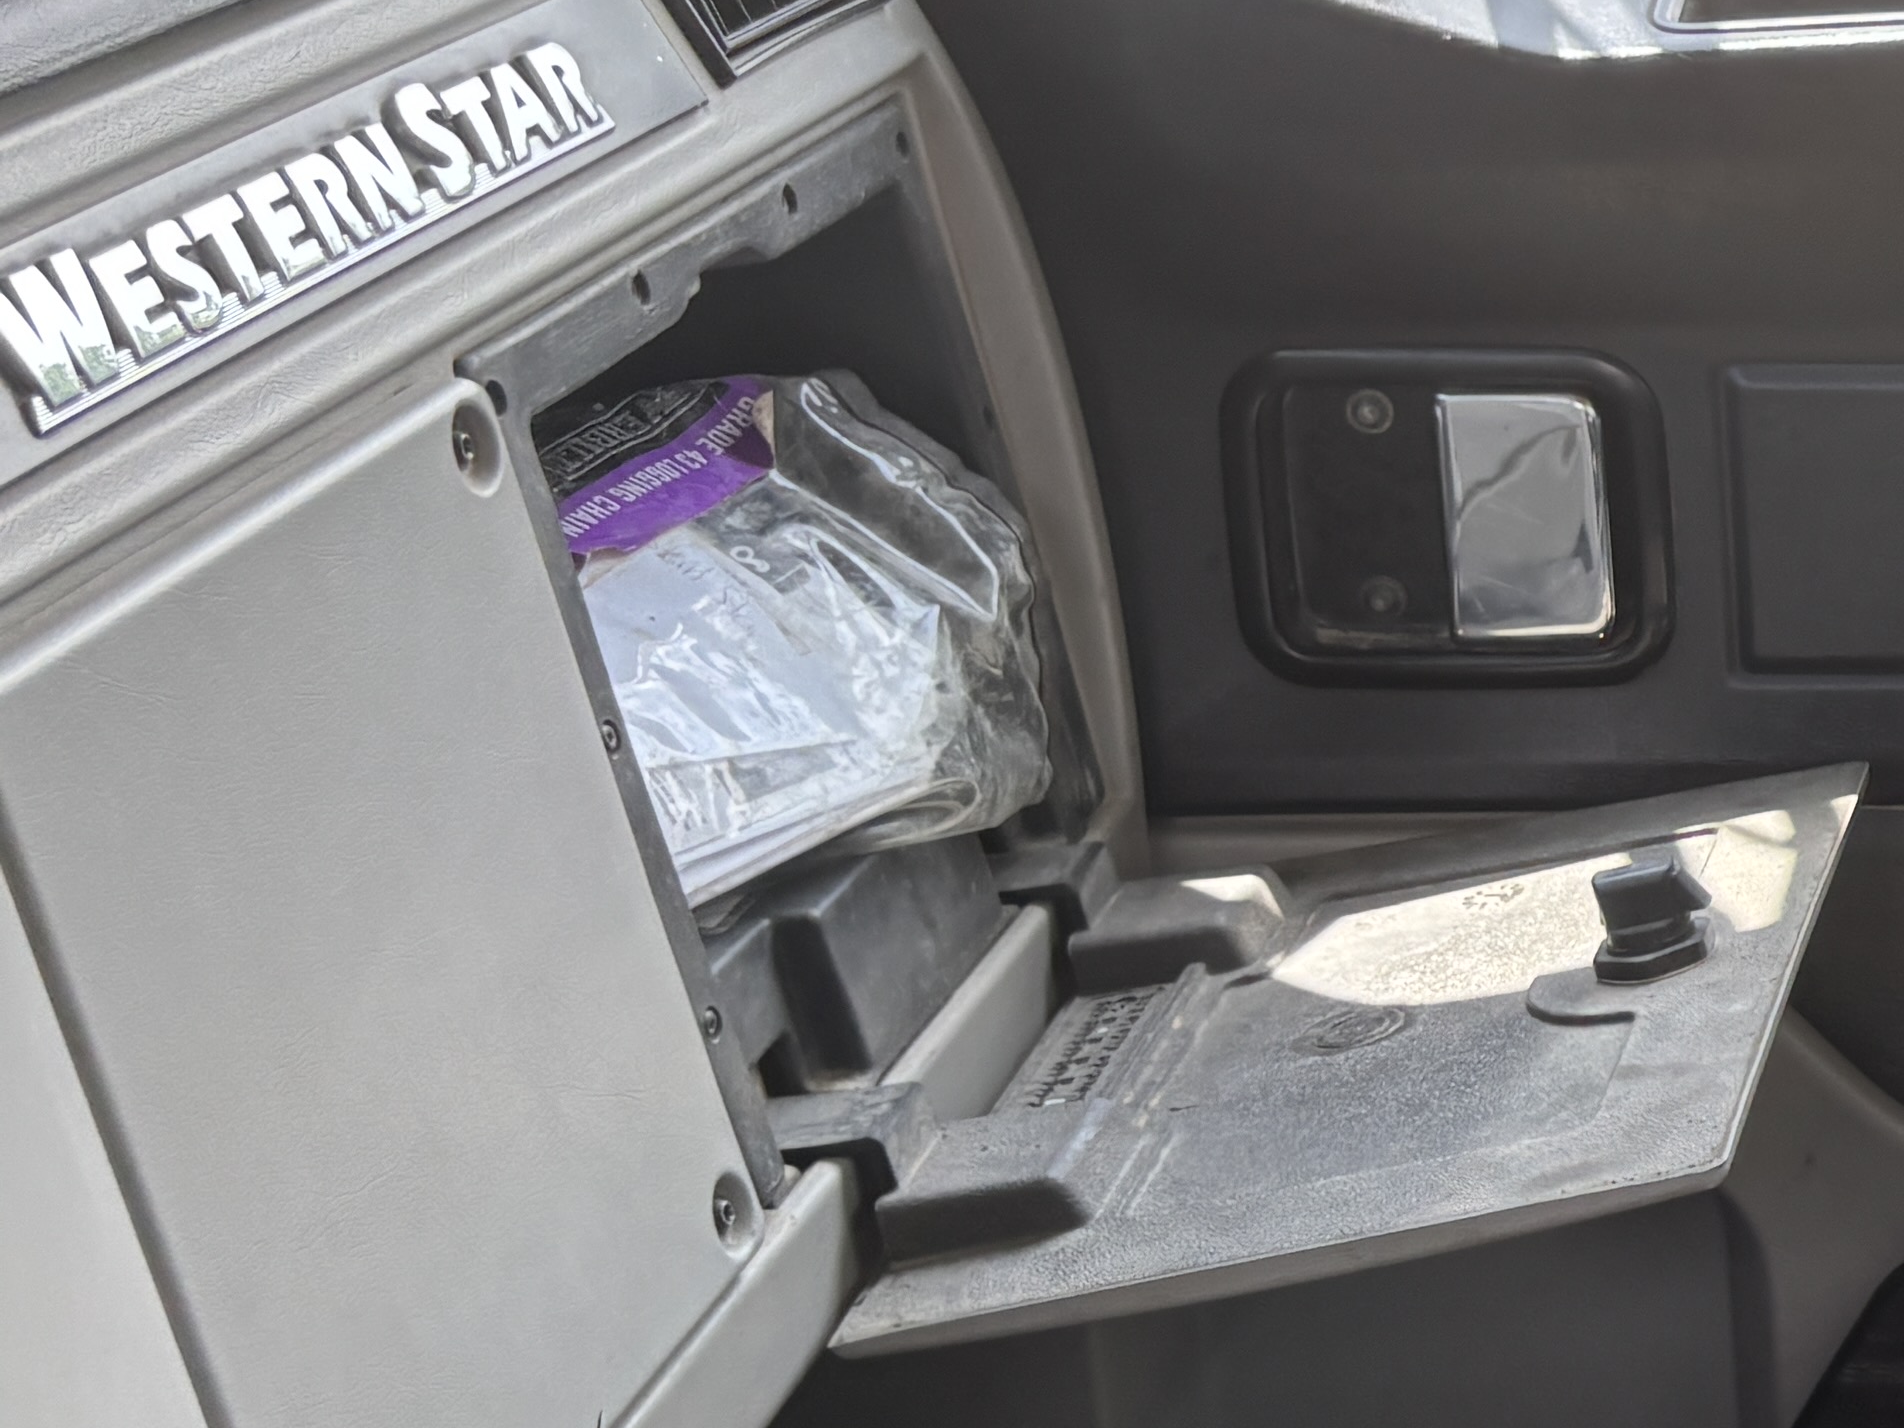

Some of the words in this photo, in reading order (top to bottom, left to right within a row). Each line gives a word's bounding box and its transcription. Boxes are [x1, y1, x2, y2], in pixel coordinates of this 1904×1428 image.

[695, 396, 756, 456] GRADE
[617, 458, 690, 503] LOGGING
[674, 448, 708, 471] 43
[560, 494, 621, 538] CHAIN
